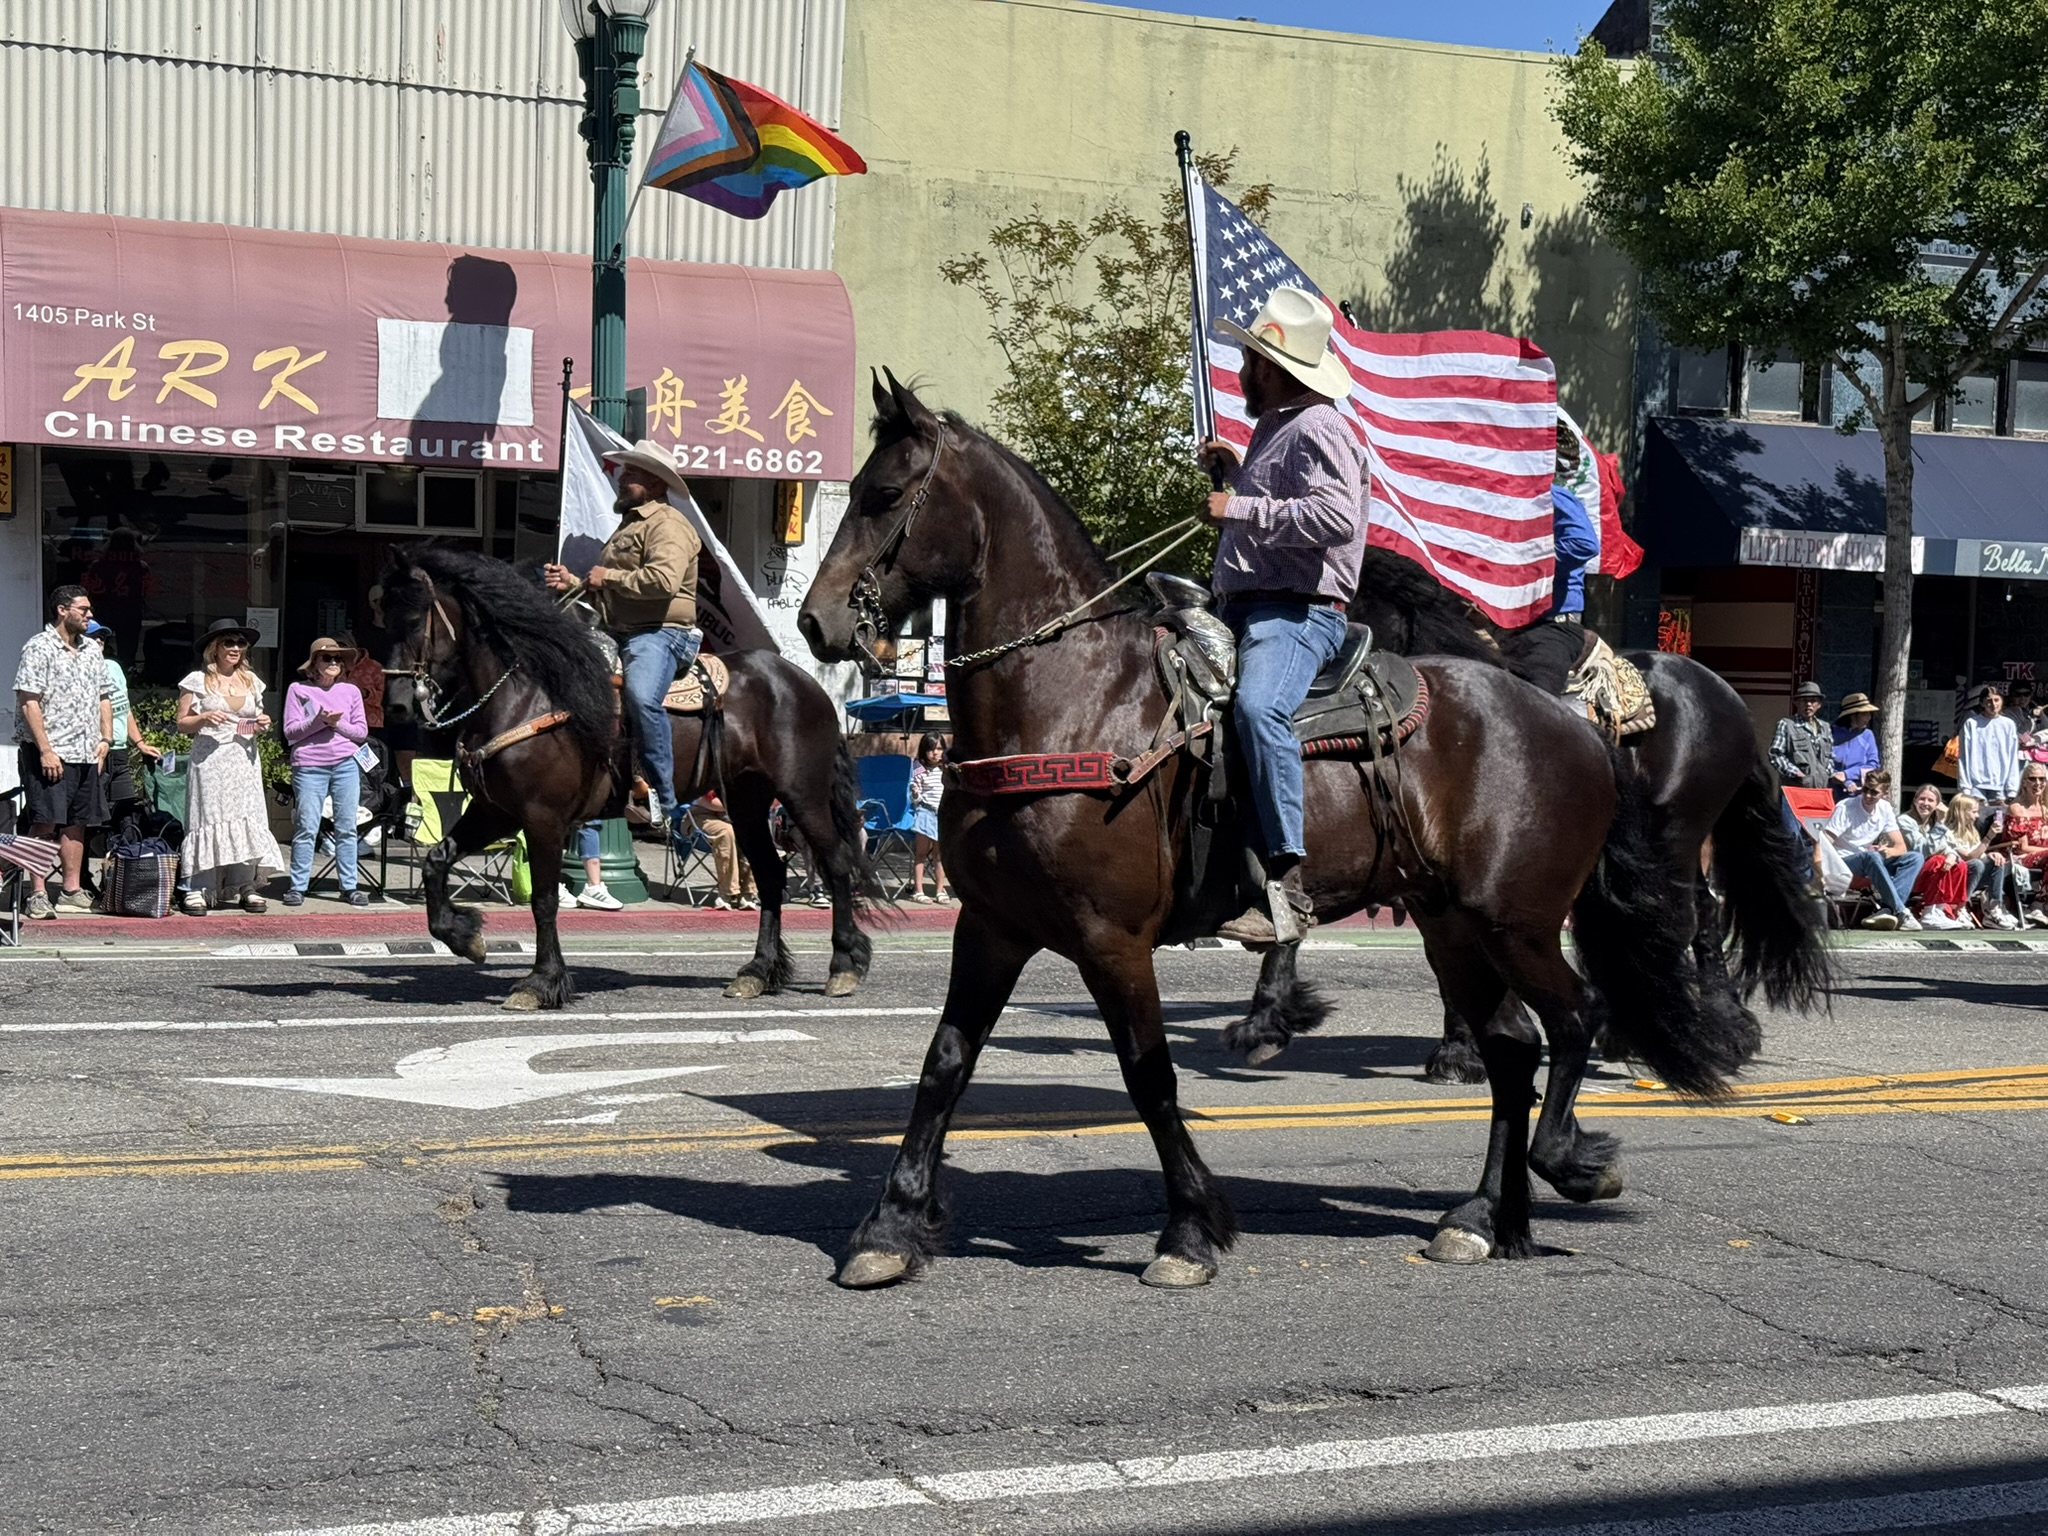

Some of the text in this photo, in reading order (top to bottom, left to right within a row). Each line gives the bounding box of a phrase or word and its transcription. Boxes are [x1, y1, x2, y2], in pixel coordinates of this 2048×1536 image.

[13, 302, 156, 332] 1405 Park St
[62, 335, 328, 415] ARK
[569, 367, 834, 444] 舟美食
[44, 410, 544, 464] Chinese Restaurant
[1983, 544, 2033, 574] Bella
[2002, 661, 2036, 681] TK
